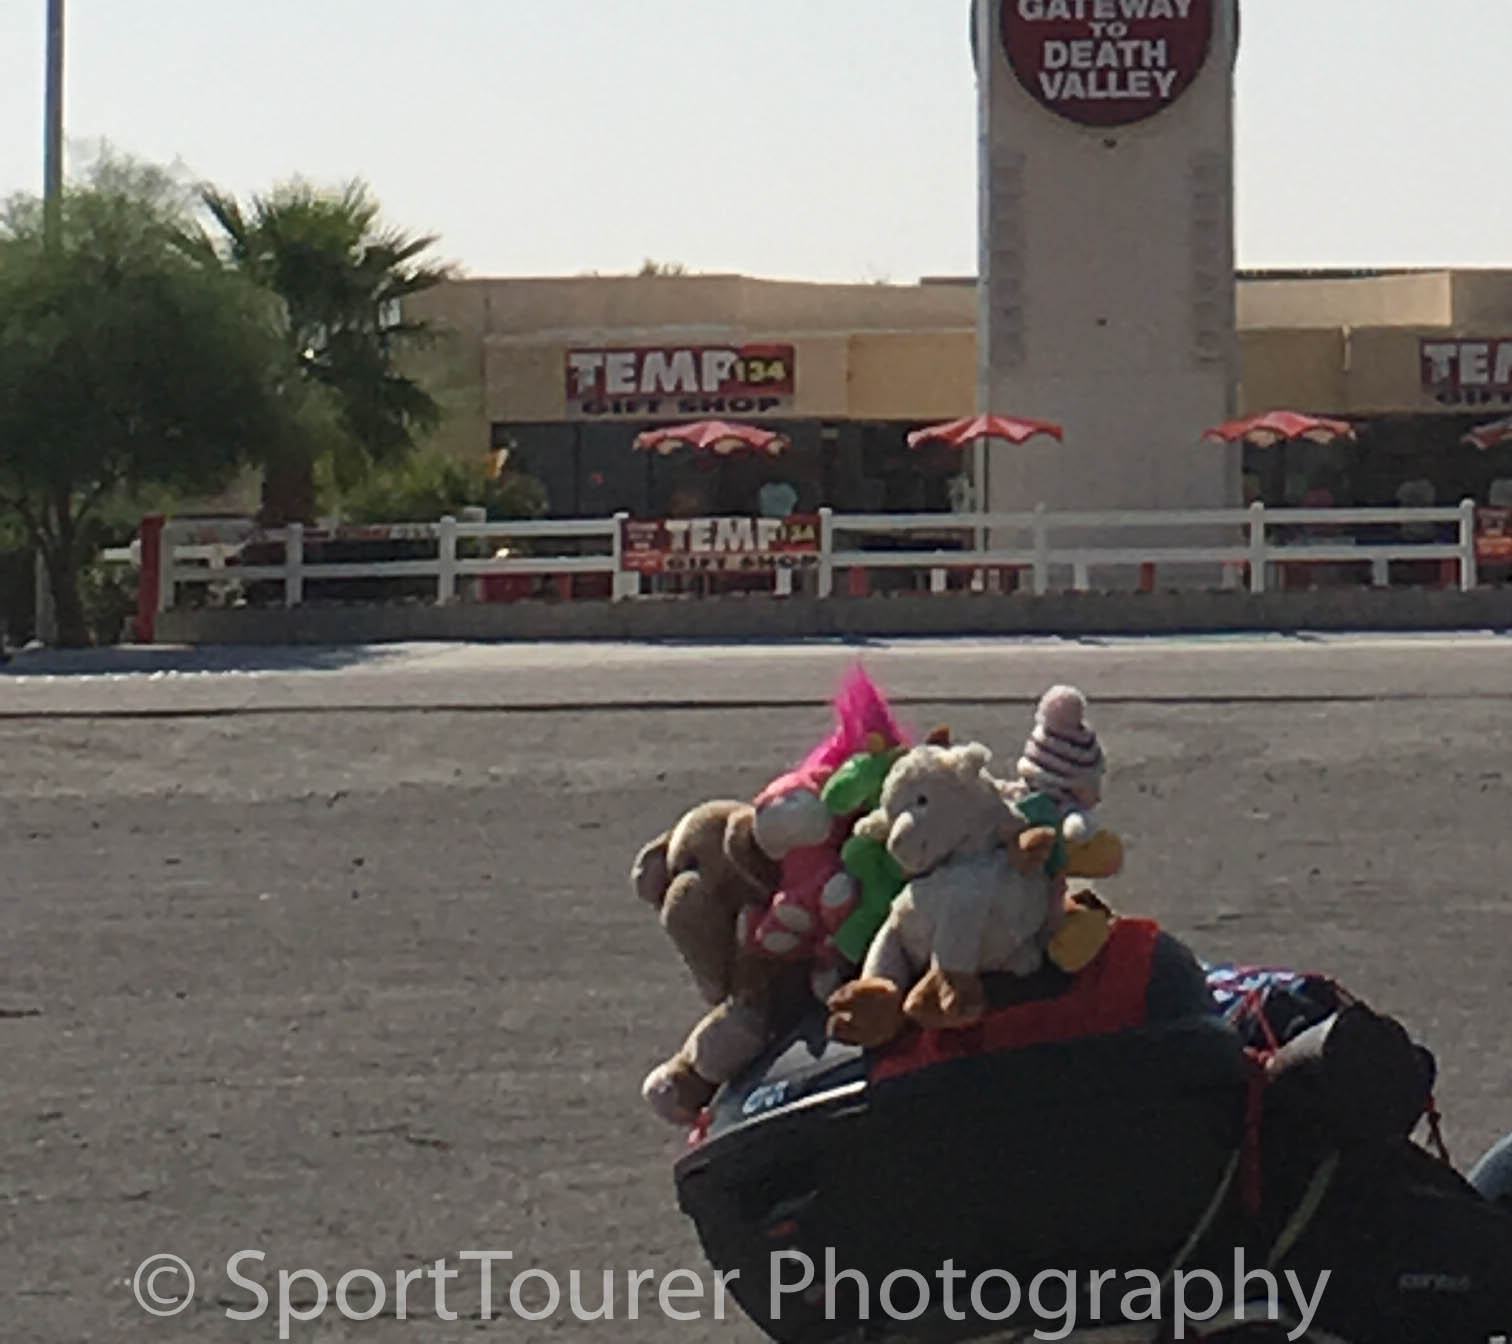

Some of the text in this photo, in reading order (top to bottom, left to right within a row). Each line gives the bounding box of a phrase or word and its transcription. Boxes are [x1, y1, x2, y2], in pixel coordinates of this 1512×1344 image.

[1088, 23, 1128, 38] TO
[1044, 40, 1166, 68] DEATH
[1039, 71, 1178, 100] VALLEY
[569, 350, 786, 394] TEMP 134
[581, 396, 780, 414] GIFT SHOP
